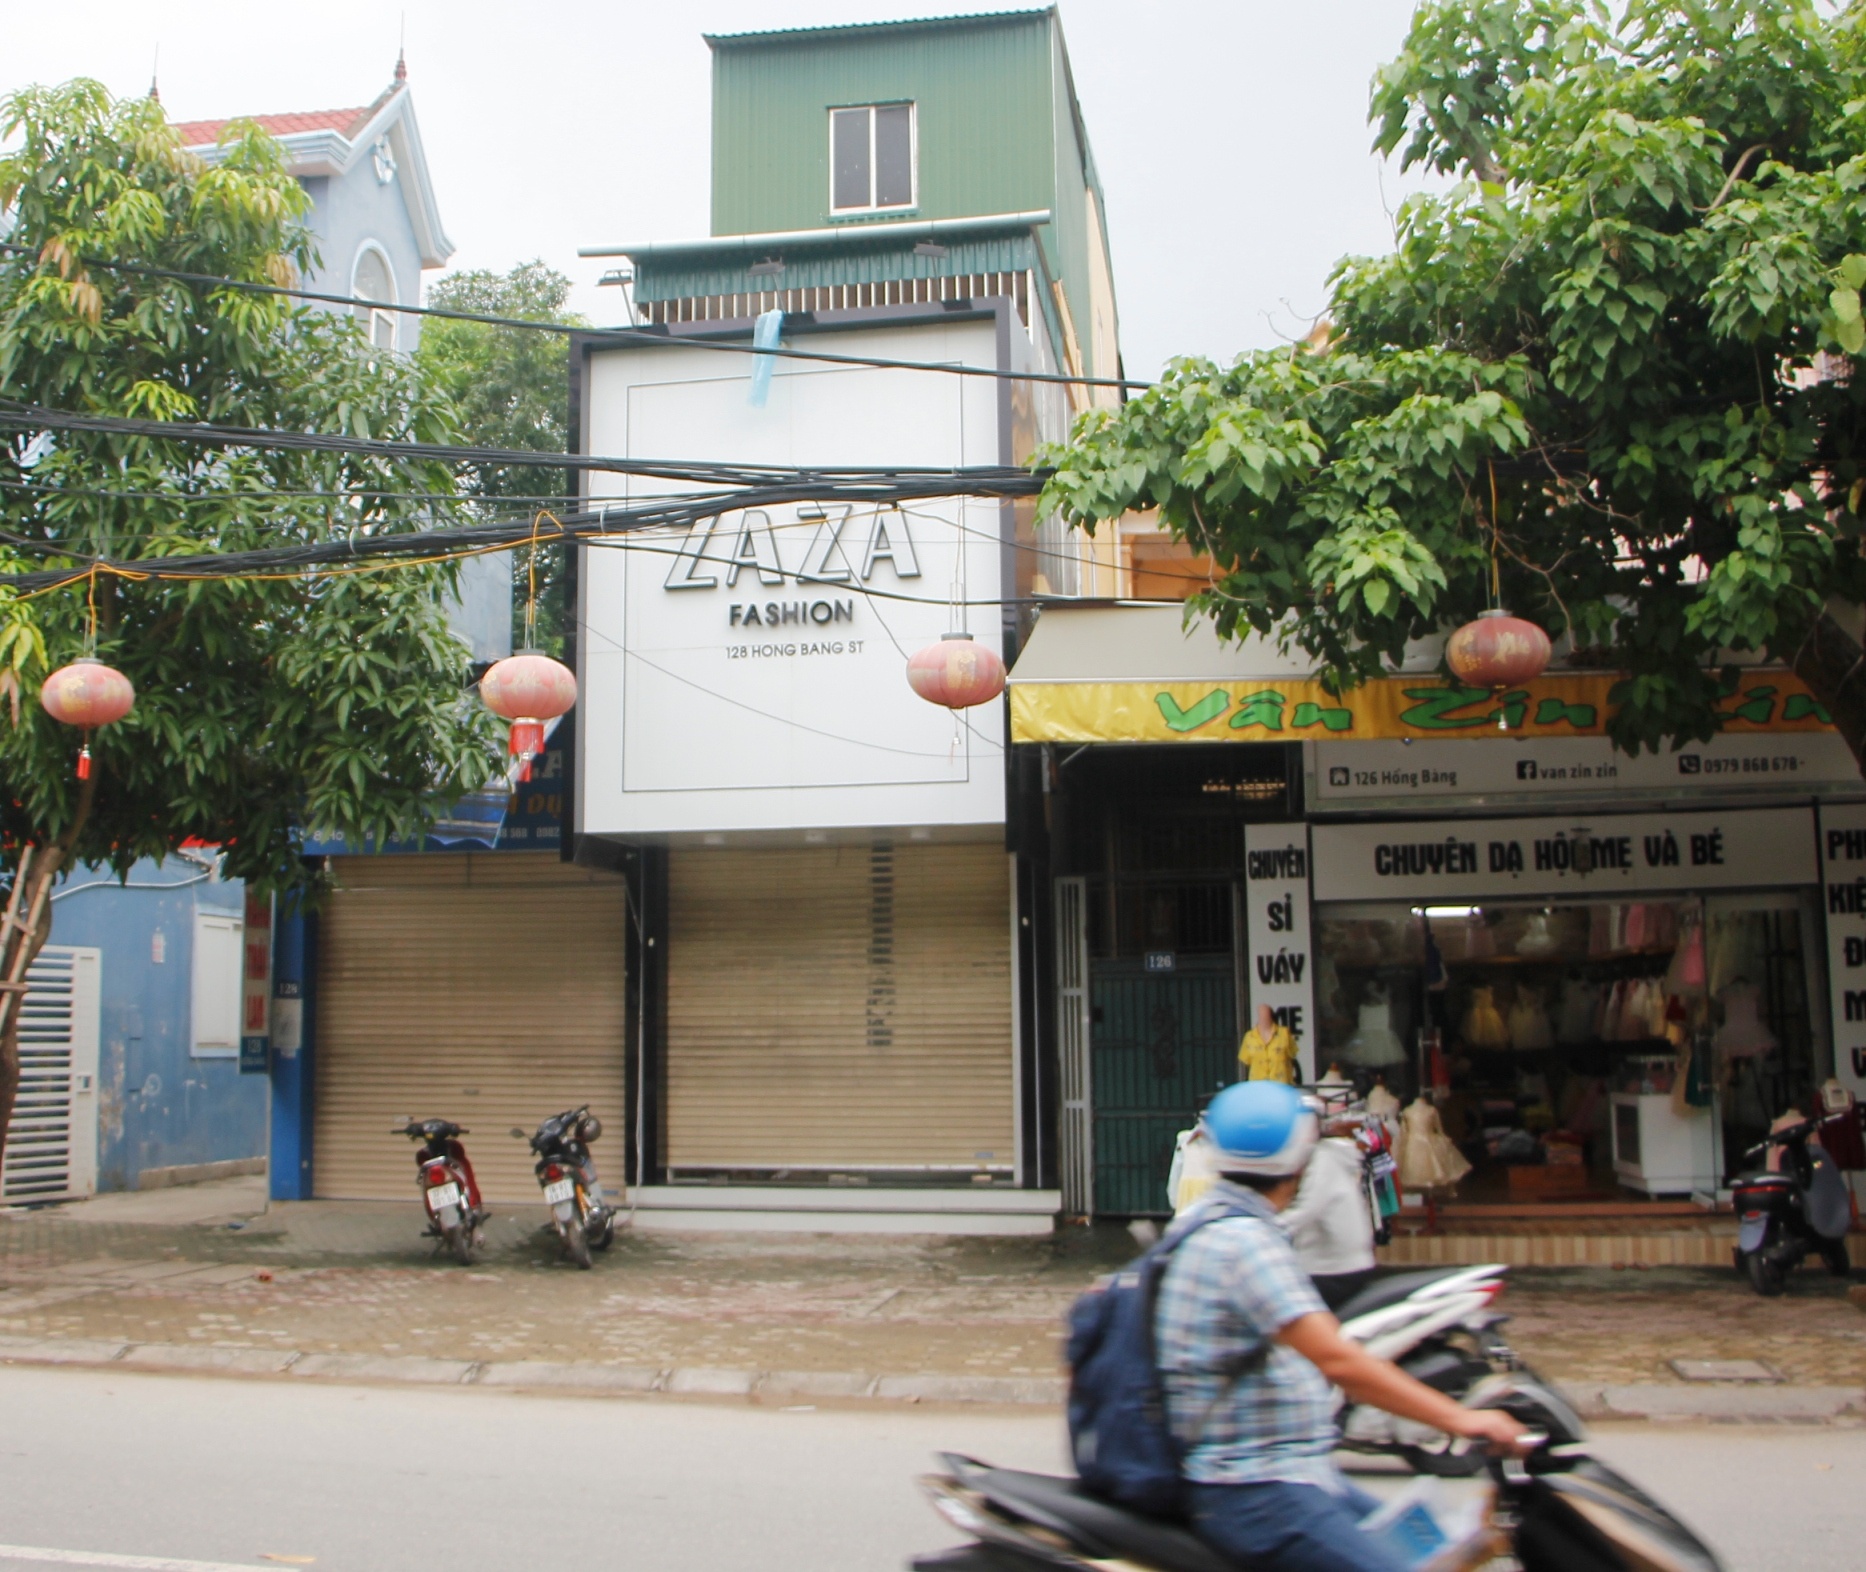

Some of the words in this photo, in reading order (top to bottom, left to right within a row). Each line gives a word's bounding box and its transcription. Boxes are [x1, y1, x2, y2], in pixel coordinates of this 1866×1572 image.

[664, 499, 921, 590] ZAZA
[729, 600, 853, 627] FASHION
[725, 646, 748, 659] 128
[751, 643, 797, 658] HONG
[800, 641, 844, 656] BANG
[848, 640, 865, 654] ST
[1354, 771, 1378, 786] 126
[1540, 768, 1567, 780] van
[1704, 759, 1739, 774] 0979
[1374, 836, 1478, 876] CHUYÊN
[1489, 841, 1524, 878] DẠ
[1588, 836, 1631, 874] MẸ
[1644, 829, 1680, 867] VÀ
[1690, 827, 1724, 865] BÉ
[1828, 831, 1866, 859] PH
[1248, 845, 1305, 880] CHUYÊN
[1150, 955, 1172, 968] 126
[1257, 947, 1305, 984] VÁY
